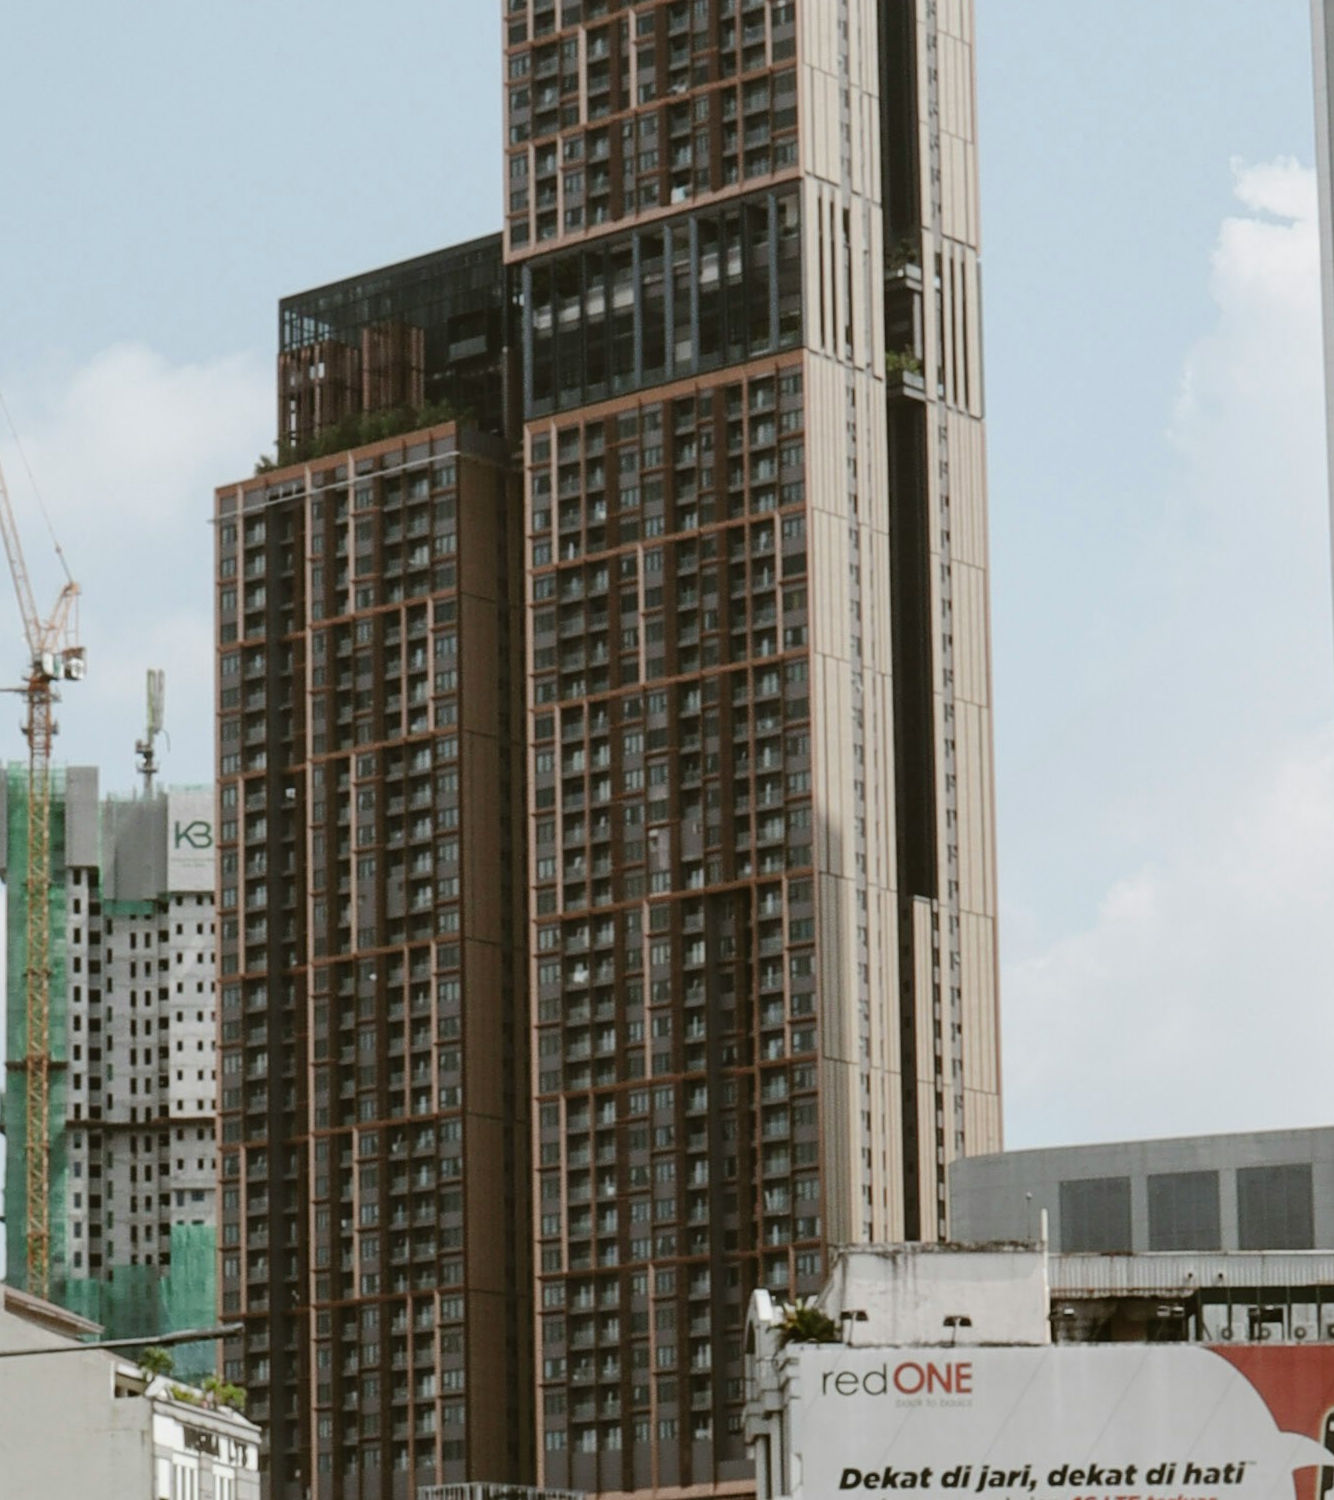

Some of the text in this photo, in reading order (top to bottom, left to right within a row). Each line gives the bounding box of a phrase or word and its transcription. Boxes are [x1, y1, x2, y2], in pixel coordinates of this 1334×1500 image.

[822, 1361, 973, 1396] redONE
[838, 1467, 933, 1490] Dekat
[941, 1465, 972, 1488] di
[975, 1465, 1038, 1492] jari,
[1047, 1463, 1138, 1487] dekat
[1145, 1462, 1177, 1485] di
